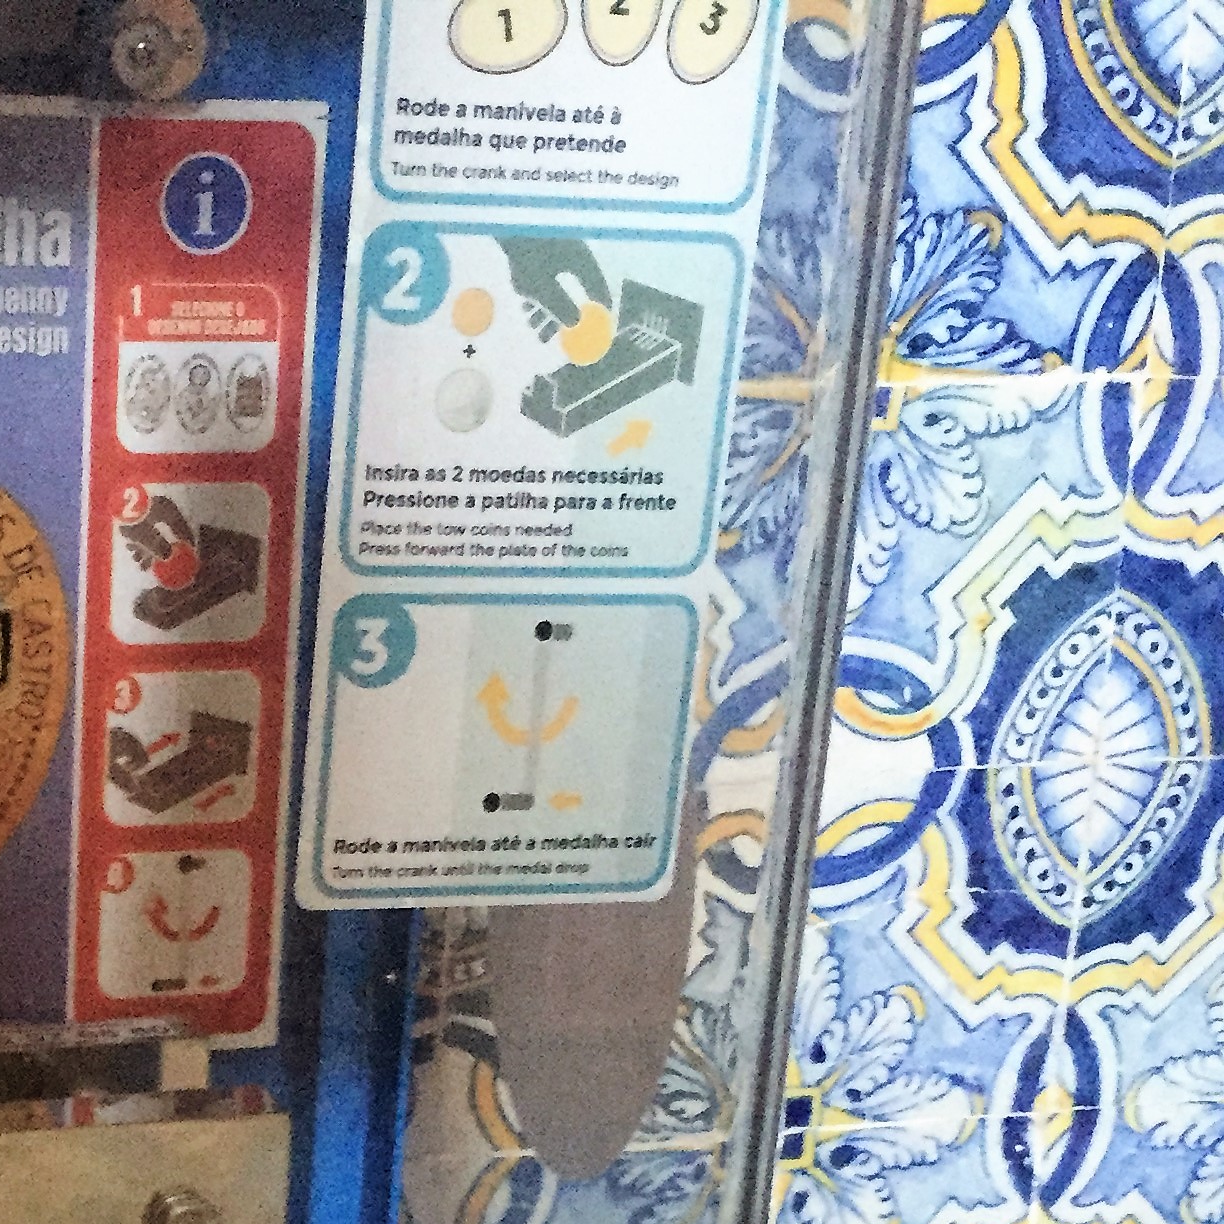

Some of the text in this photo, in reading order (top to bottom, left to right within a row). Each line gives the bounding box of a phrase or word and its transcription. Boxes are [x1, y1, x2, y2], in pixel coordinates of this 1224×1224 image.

[497, 8, 514, 43] 1
[700, 0, 729, 36] 3
[396, 97, 450, 117] Rode
[456, 103, 467, 118] a
[474, 102, 566, 122] manivela
[573, 105, 605, 124] até
[394, 127, 627, 153] medalha que pretende
[392, 161, 680, 189] Turn the crank and select the design
[382, 246, 422, 310] 2
[131, 284, 142, 317] 1
[365, 464, 664, 486] Insira as 2 moedas necessárias
[123, 488, 139, 517] 2
[363, 490, 677, 513] Pressione a patilha para a frente
[361, 521, 402, 535] Place
[407, 521, 433, 536] the
[470, 523, 510, 537] coins
[515, 523, 573, 537] needed
[358, 542, 628, 559] Press forward the plate of the coins
[350, 617, 389, 675] 3
[334, 833, 657, 853] Rode a manivela até a medalha cair
